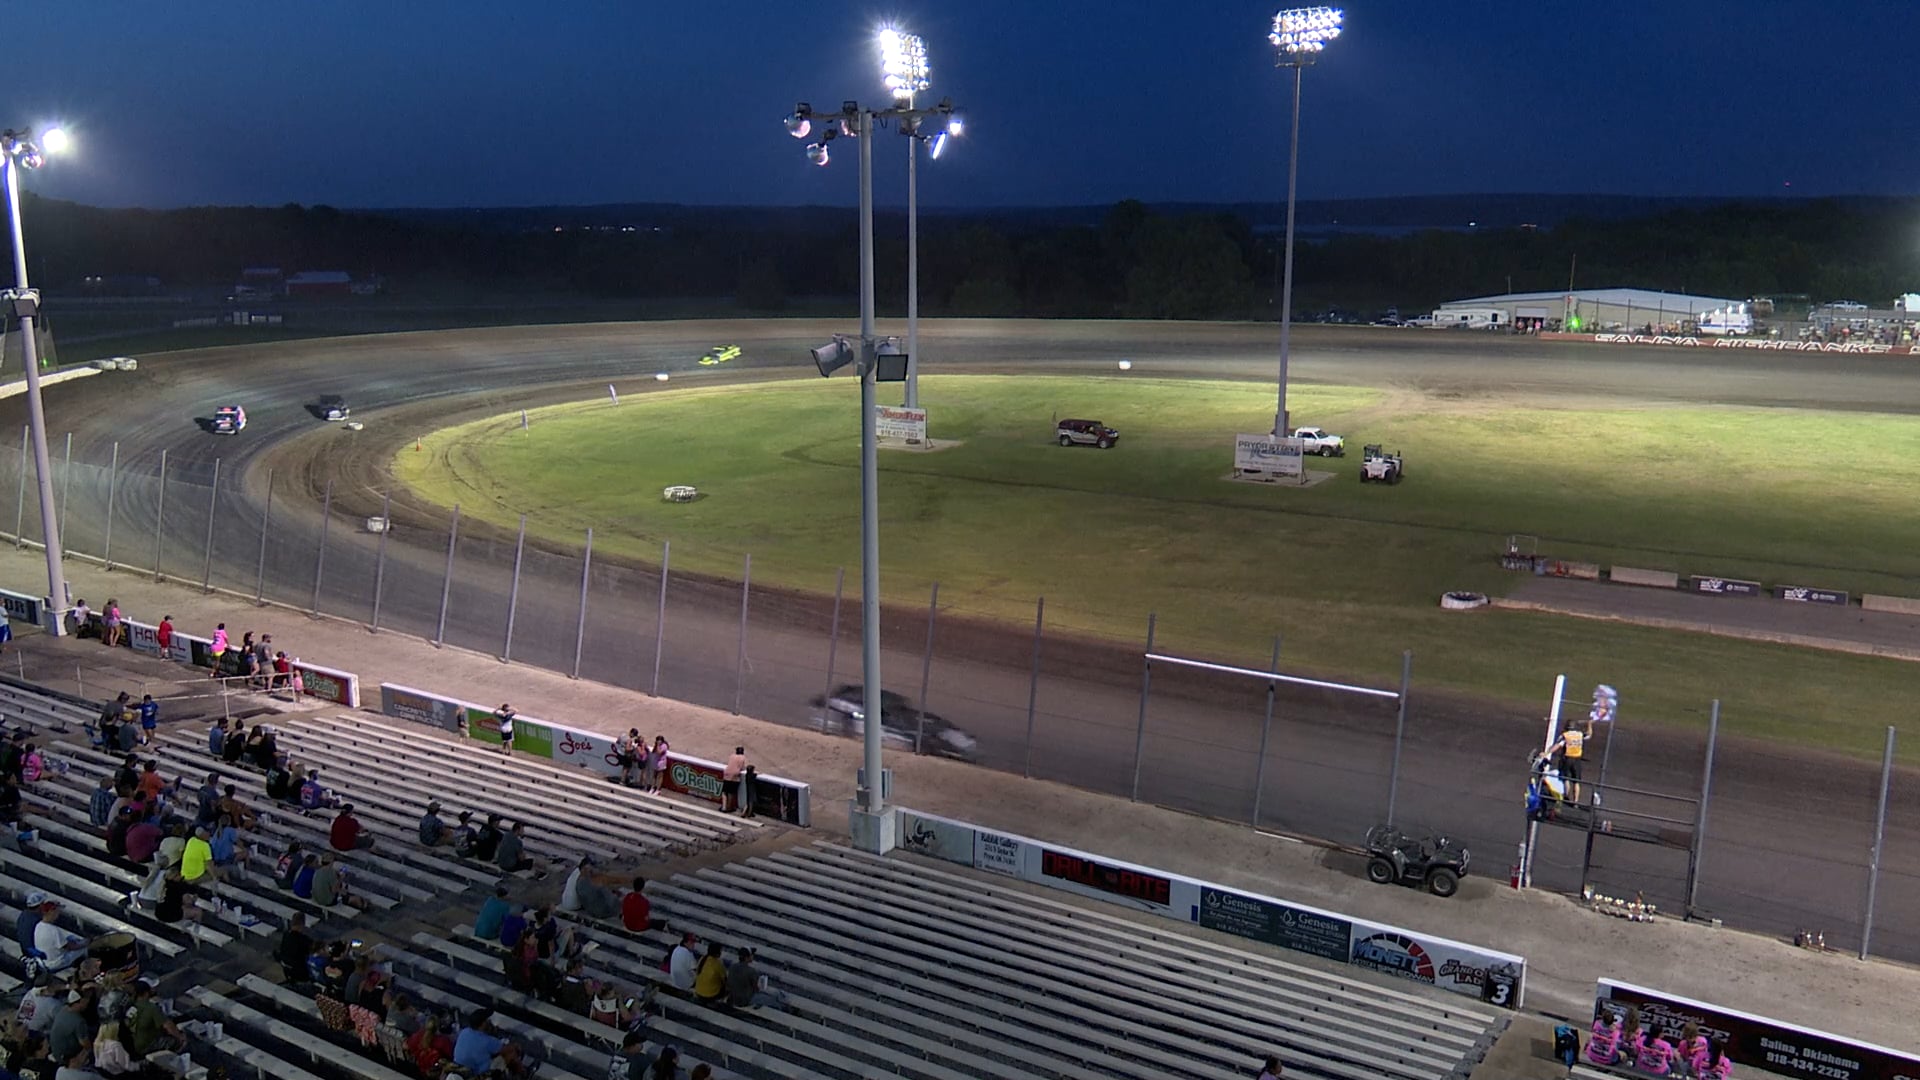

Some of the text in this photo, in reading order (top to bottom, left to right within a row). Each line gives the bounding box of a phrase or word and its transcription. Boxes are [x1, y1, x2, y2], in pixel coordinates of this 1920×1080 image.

[1595, 333, 1701, 347] SALINA
[1713, 338, 1893, 354] HIGHBANKS
[560, 731, 592, 755] Joe's
[672, 764, 724, 796] O'Reilly
[1043, 853, 1170, 902] DRILL RITE
[1222, 895, 1261, 912] Genesis
[1298, 913, 1339, 931] Genesis
[1352, 938, 1421, 972] MONETT
[1377, 963, 1434, 984] SPEEDWAY
[1440, 963, 1473, 976] GRAND
[1455, 972, 1482, 985] LAD
[1490, 983, 1510, 1005] 3
[1638, 1010, 1731, 1043] ERVCE
[1760, 1037, 1860, 1070] Salina, Oklahoma
[1766, 1052, 1850, 1080] 918-434-2282
